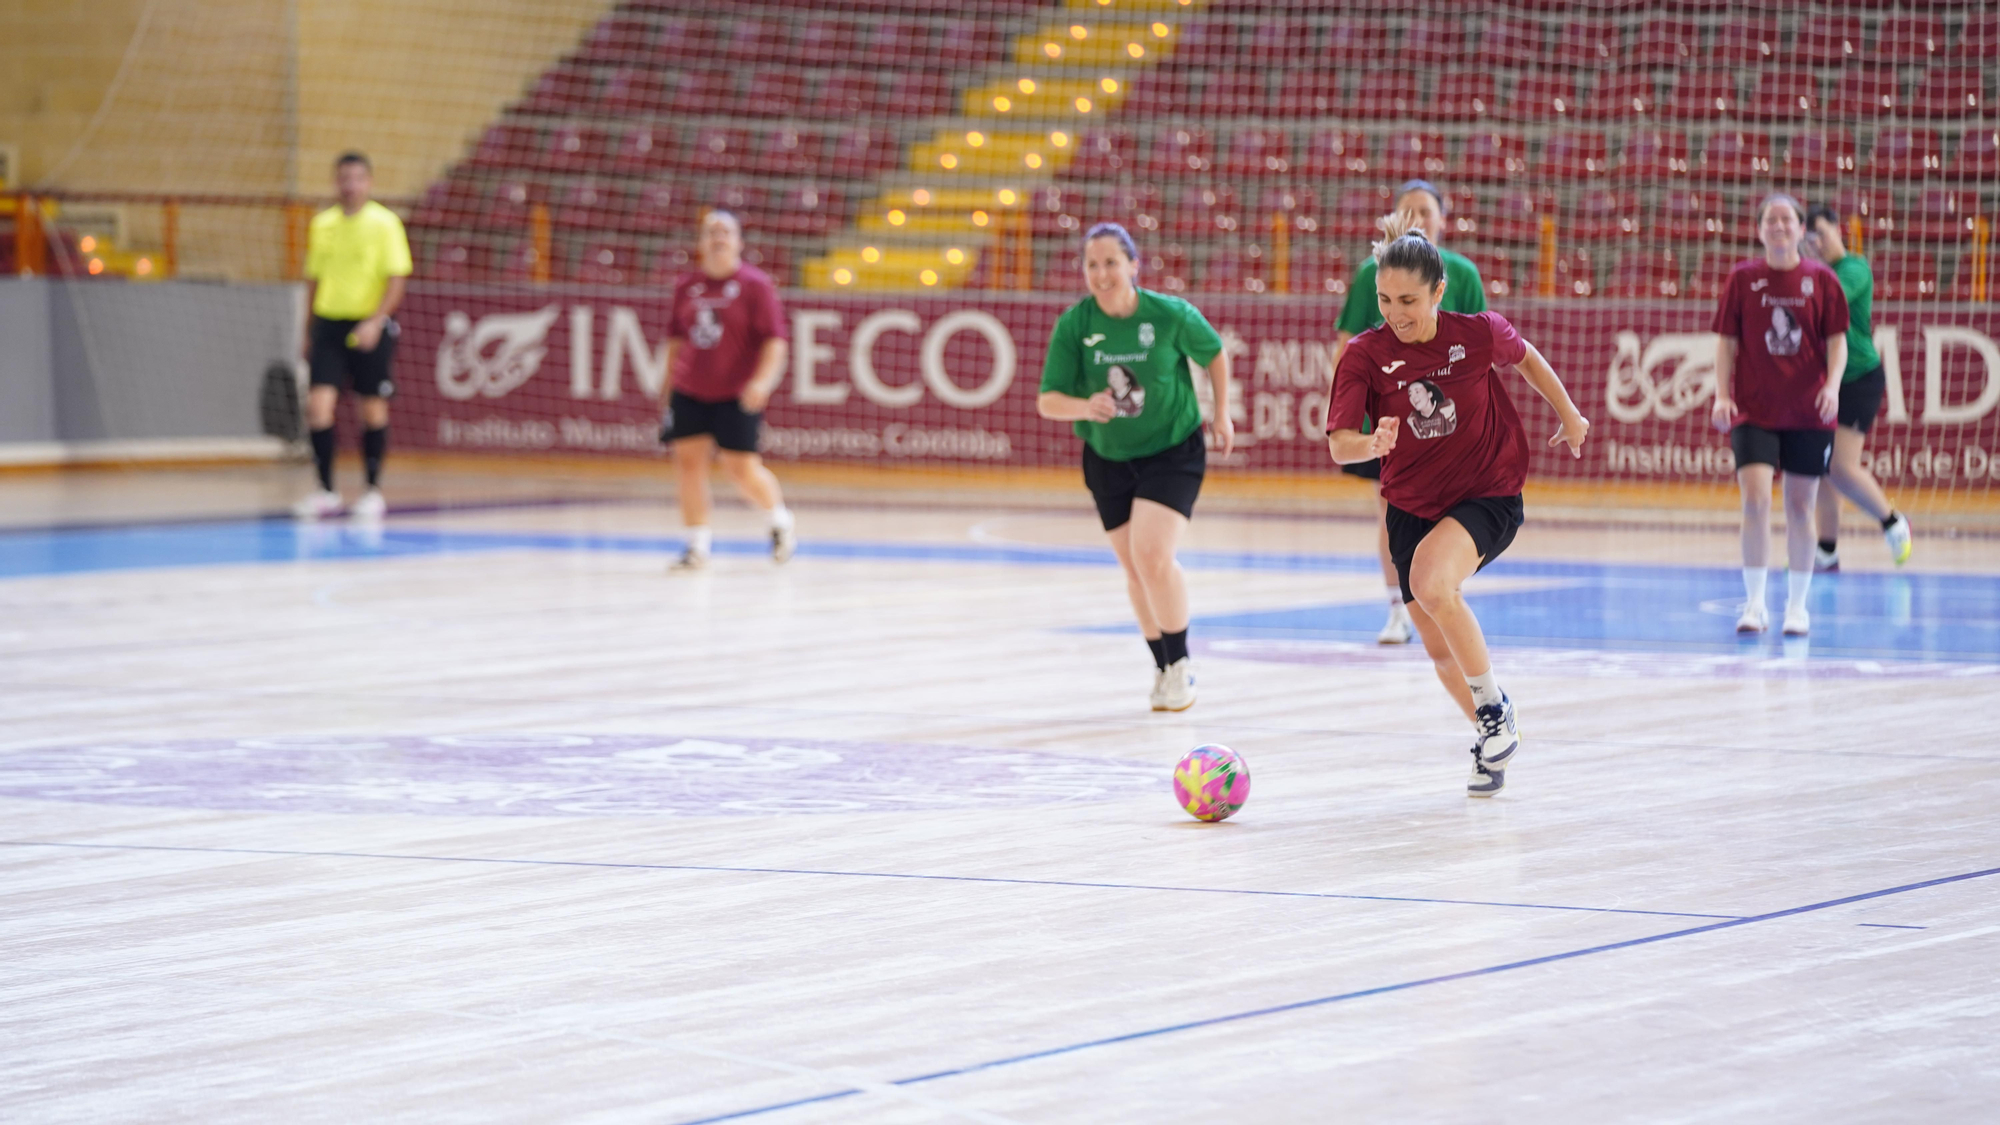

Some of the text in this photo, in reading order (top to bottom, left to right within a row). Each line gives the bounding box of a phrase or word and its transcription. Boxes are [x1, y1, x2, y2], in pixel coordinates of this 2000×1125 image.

[568, 304, 1017, 408] IMECO
[1252, 392, 1296, 440] DE
[1607, 439, 1735, 475] Instituto
[1911, 443, 1953, 479] de
